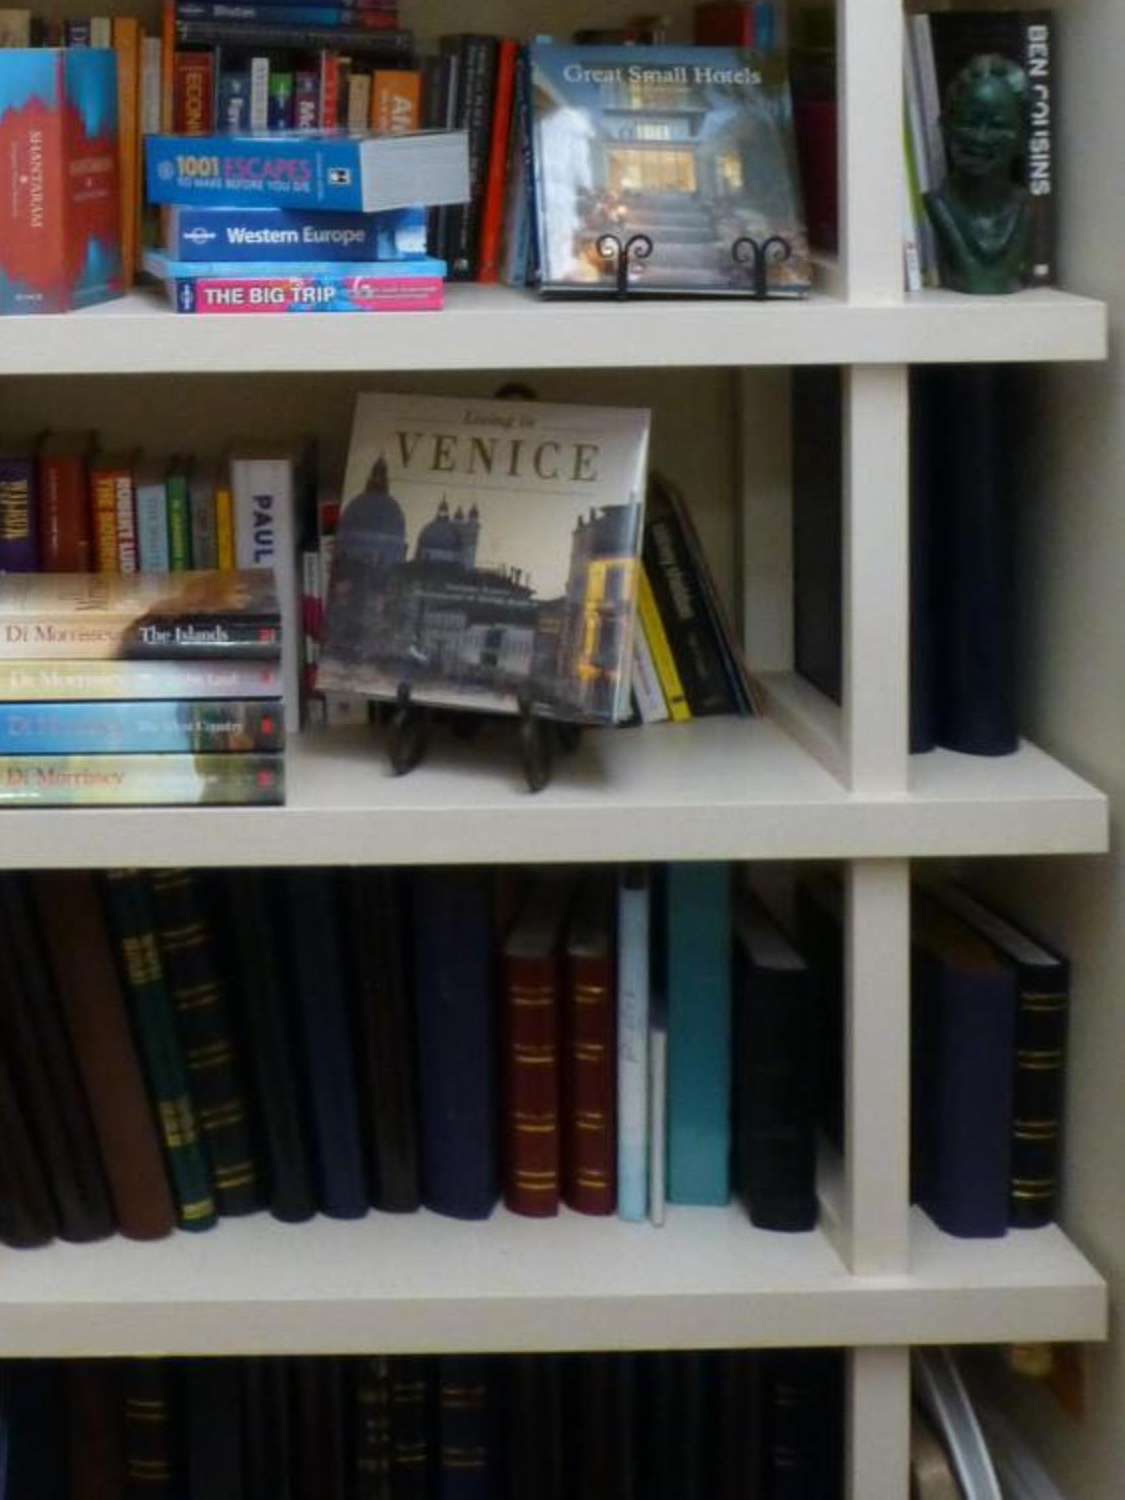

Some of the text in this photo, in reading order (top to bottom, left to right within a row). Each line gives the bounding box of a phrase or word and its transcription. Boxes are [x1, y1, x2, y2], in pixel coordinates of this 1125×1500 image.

[562, 63, 762, 87] Great Small Hotels
[1026, 24, 1052, 197] BEN COUSINS
[28, 130, 43, 228] SHANTARAM
[177, 156, 311, 181] 1001 ESCAPES
[226, 225, 366, 247] Western Europe
[203, 287, 244, 305] THE
[247, 285, 286, 304] BIG
[291, 284, 336, 304] TRIP
[394, 430, 602, 483] VENICE
[253, 494, 274, 564] PAUL
[138, 624, 230, 645] The Islands
[36, 768, 126, 791] Morrissey
